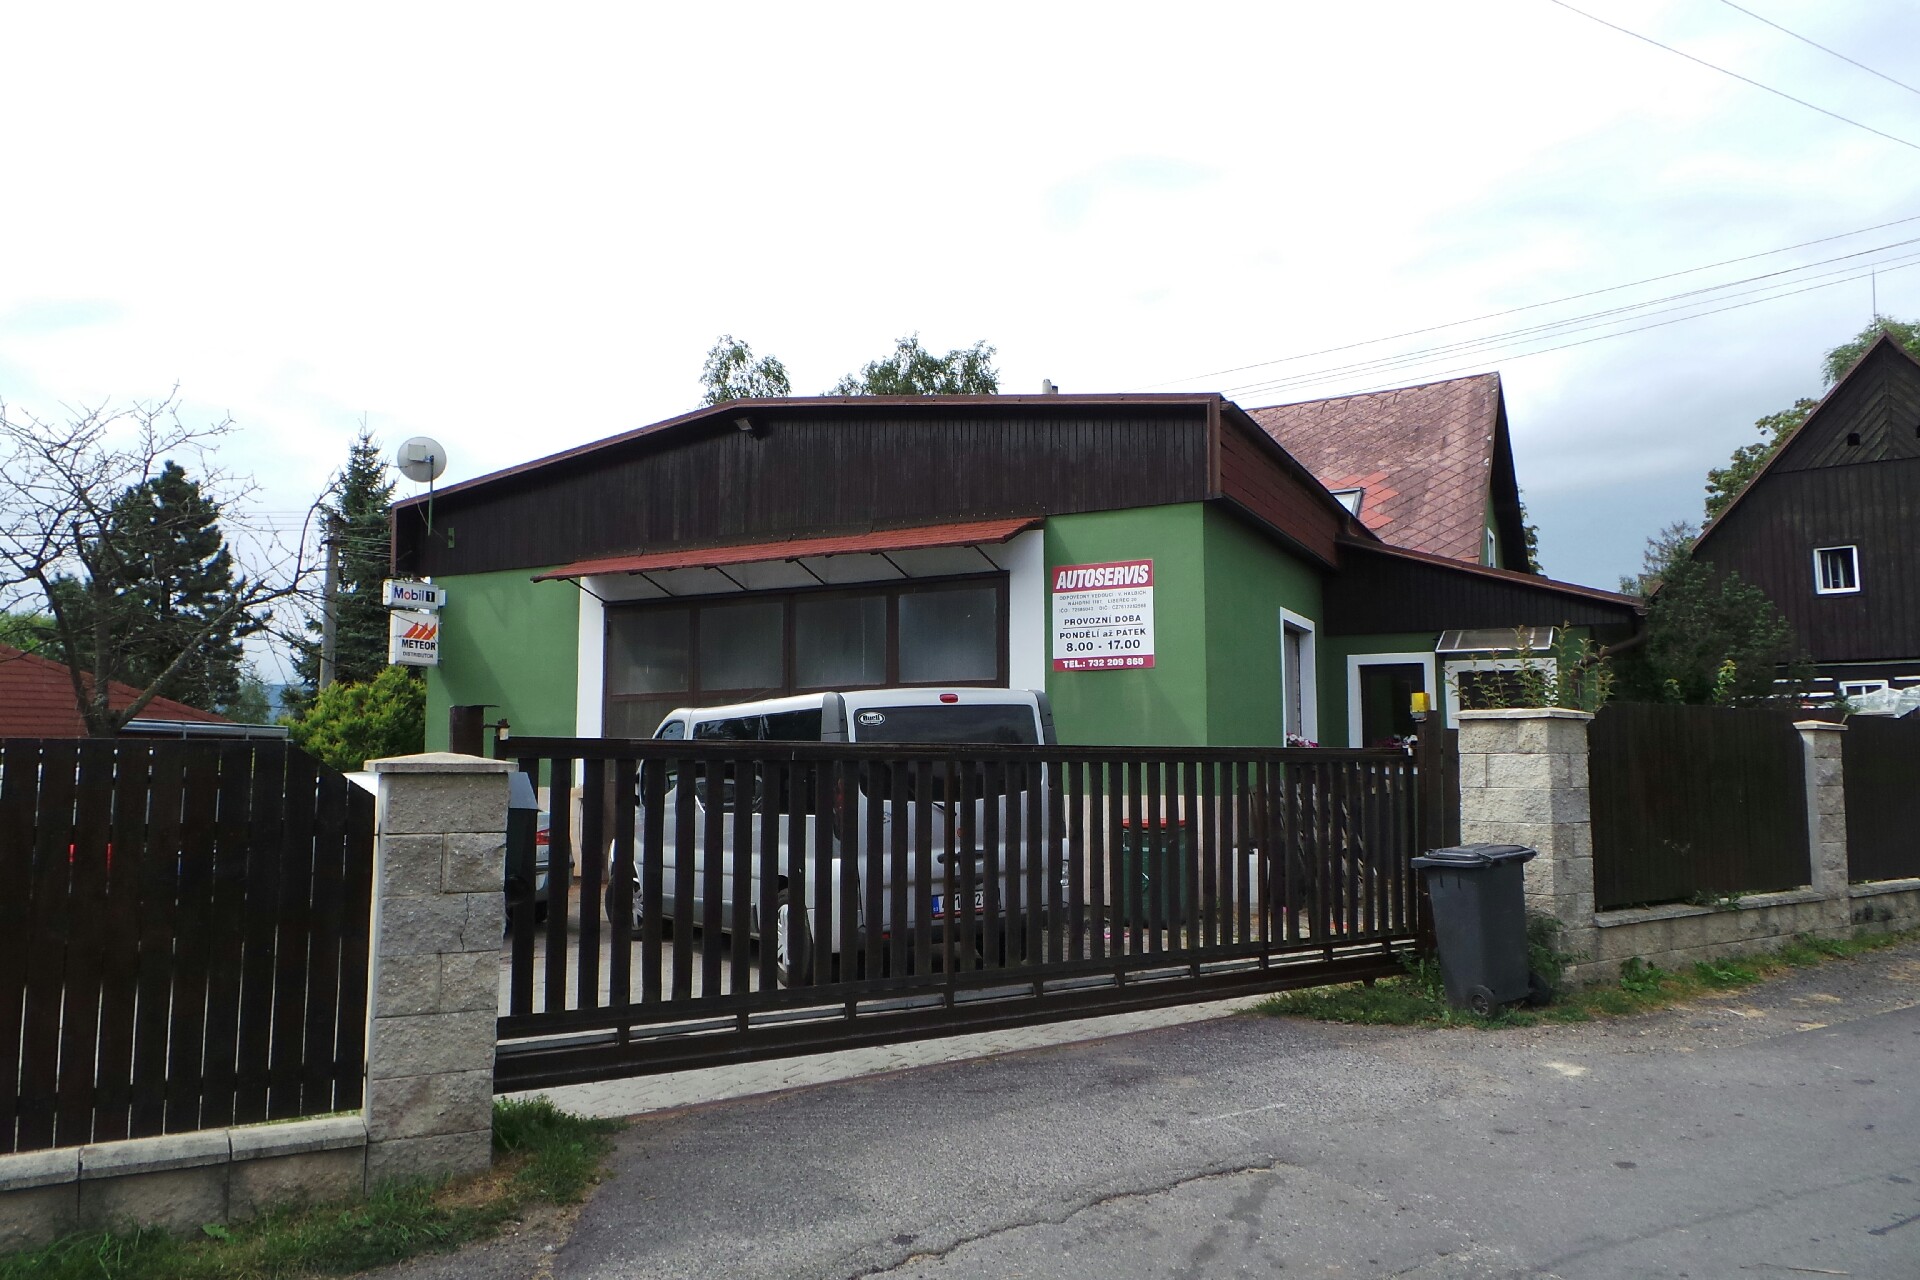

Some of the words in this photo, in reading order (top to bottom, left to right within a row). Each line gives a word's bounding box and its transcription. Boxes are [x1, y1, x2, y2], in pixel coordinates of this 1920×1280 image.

[1056, 564, 1149, 589] AUTOSERVIS
[394, 586, 424, 601] Mobil
[1064, 615, 1112, 625] PROVOZNÍ
[1115, 615, 1142, 623] DOBA
[1060, 629, 1100, 639] PONDĚLÍ
[402, 639, 436, 650] METEOR
[1066, 642, 1094, 652] 8.00
[1108, 640, 1140, 650] 17.00
[1063, 660, 1086, 668] TEL.:
